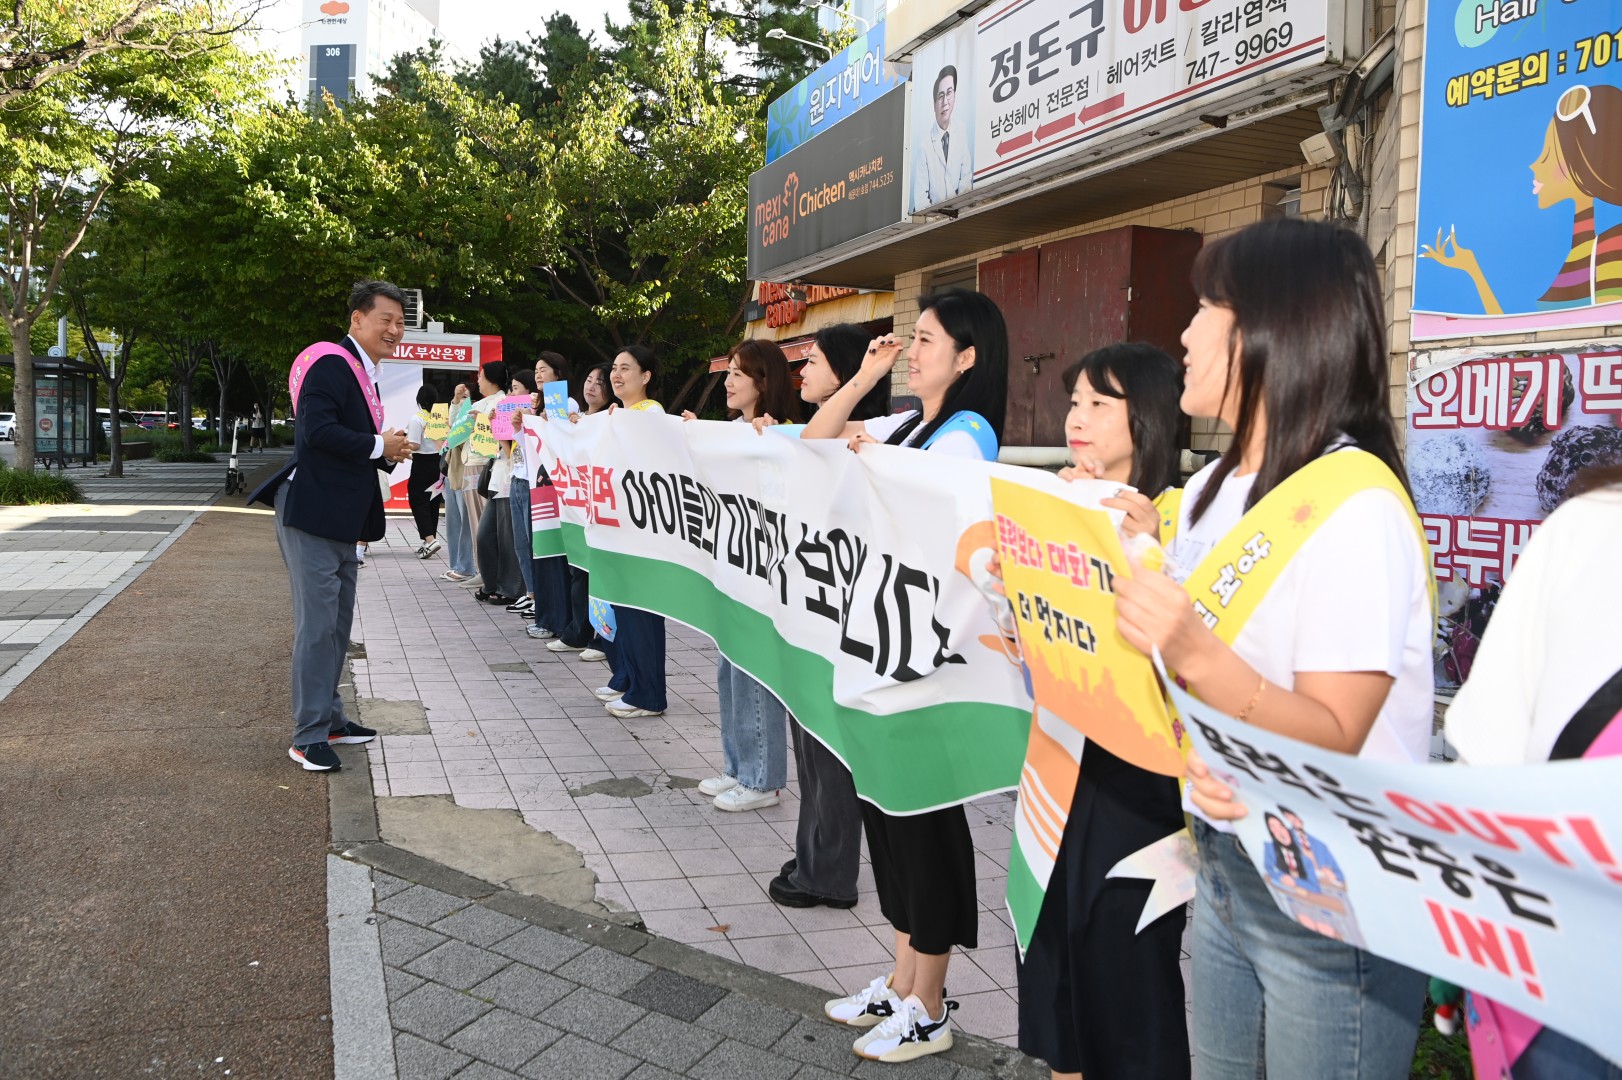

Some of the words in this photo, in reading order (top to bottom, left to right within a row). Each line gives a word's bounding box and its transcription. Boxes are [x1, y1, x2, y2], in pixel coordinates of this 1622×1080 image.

[325, 47, 341, 57] 306
[989, 0, 1106, 103] 정돈규
[1446, 49, 1549, 109] 예약문의
[809, 45, 880, 127] 원지헤어
[990, 98, 1040, 139] 남성헤어
[1046, 75, 1089, 114] 전문점
[1106, 37, 1177, 85] 헤어컷트
[755, 193, 781, 228] mexi
[799, 180, 846, 217] Chicken
[762, 215, 789, 248] cana
[766, 298, 793, 328] cana
[415, 346, 466, 361] 부산은행
[1413, 356, 1563, 428] 오메기
[622, 469, 721, 560] 아이들의
[1046, 542, 1114, 593] 대화가
[1018, 591, 1032, 623] 더
[1034, 594, 1096, 654] 멋지다
[1331, 810, 1557, 928] 존중은
[1383, 790, 1622, 885] OUT!
[1424, 898, 1543, 999] IN!
